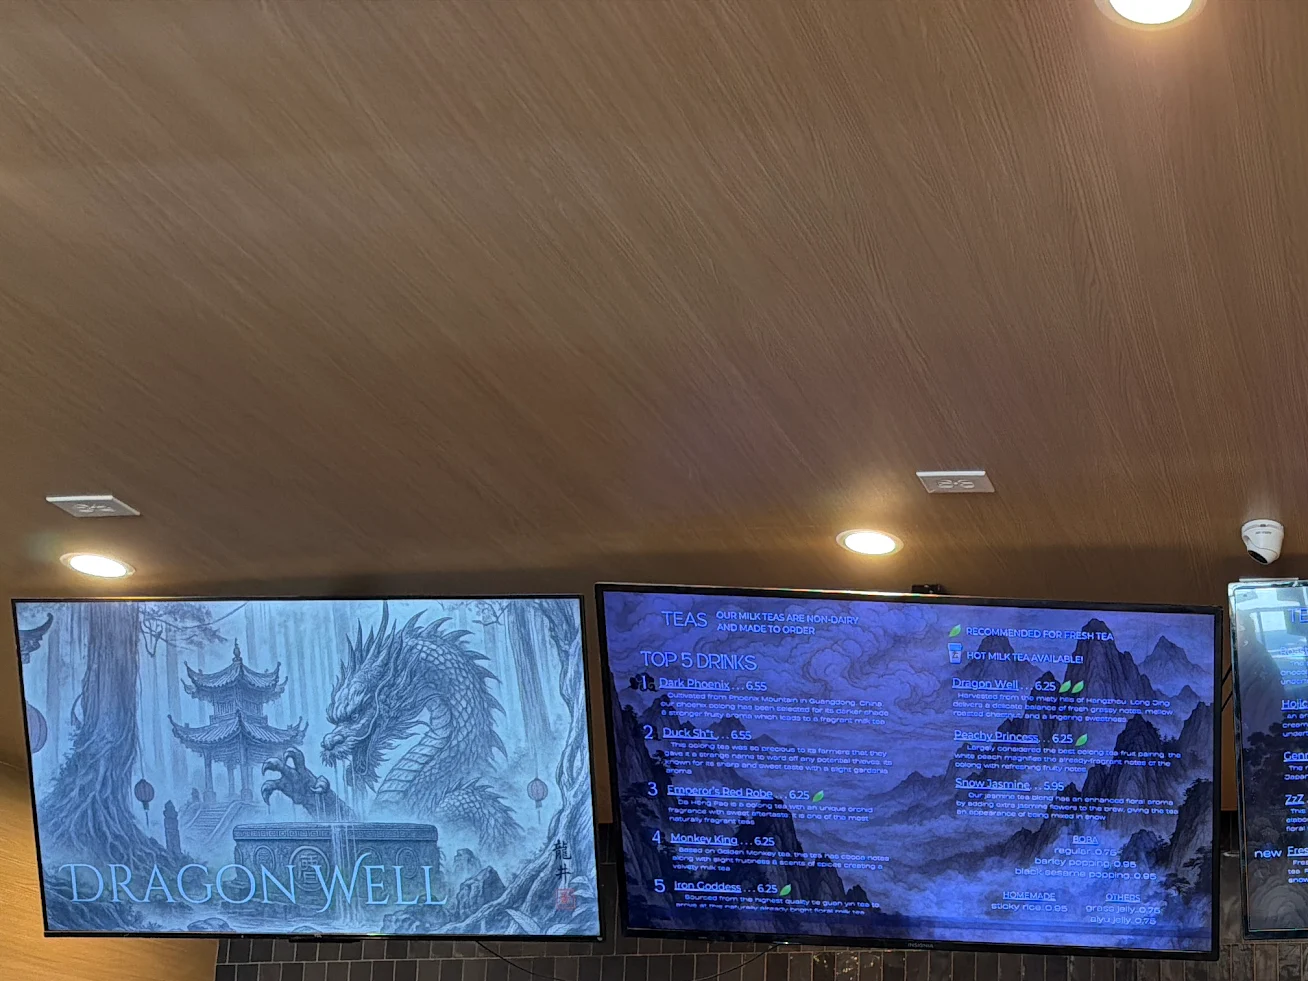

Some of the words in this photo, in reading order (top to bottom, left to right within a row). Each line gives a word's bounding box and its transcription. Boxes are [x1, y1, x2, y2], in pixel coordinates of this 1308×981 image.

[661, 610, 708, 628] TEAS
[716, 611, 737, 620] OUR
[738, 611, 761, 621] MILK
[761, 612, 785, 622] TEAS
[786, 613, 806, 623] ARE
[806, 614, 859, 625] NON-DAIRY
[717, 623, 738, 633] AND
[739, 624, 767, 634] MADE
[767, 625, 781, 634] TO
[782, 625, 816, 636] ORDER
[966, 627, 1041, 640] RECOMMENDED
[1043, 629, 1063, 640] FOR
[1064, 630, 1095, 641] FRESH
[1095, 631, 1115, 642] TEA
[640, 650, 678, 669] TOP
[681, 652, 693, 669] 5
[696, 653, 758, 671] DRINKS
[966, 651, 986, 661] HOT
[988, 652, 1011, 662] MILK
[1012, 653, 1030, 662] TEA
[1031, 653, 1084, 665] AVAILABLE!
[659, 677, 685, 689] Dark
[686, 678, 730, 690] Phoenix
[745, 681, 768, 692] 6.55
[952, 678, 992, 691] Dragon
[994, 679, 1019, 689] Well
[1034, 682, 1056, 692] 6.25
[643, 724, 654, 740] 2
[662, 727, 692, 738] Duck
[730, 730, 753, 741] 6.55
[954, 730, 994, 743] Peachy
[996, 731, 1039, 742] Princess
[1052, 734, 1073, 744] 6.25
[647, 781, 658, 797] 3
[667, 785, 720, 798] Emperor's
[722, 787, 743, 797] Red
[745, 788, 773, 799] Robe
[789, 790, 810, 800] 6.25
[955, 778, 985, 788] Snow
[987, 779, 1030, 790] Jasmine
[1043, 781, 1065, 792] 5.95
[1285, 794, 1305, 804] ZzZ
[651, 830, 661, 844] 4
[670, 833, 712, 846] Monkey
[713, 835, 738, 847] King
[754, 836, 775, 847] 6.25
[1254, 849, 1282, 860] new
[58, 863, 298, 905] DRAGON
[312, 852, 449, 914] WELL
[653, 879, 666, 894] 5
[674, 881, 695, 891] Iron
[696, 881, 742, 892] Goddess
[757, 884, 778, 894] 6.25
[1003, 892, 1056, 901] HOMEMADE
[1106, 893, 1141, 902] OTHERS
